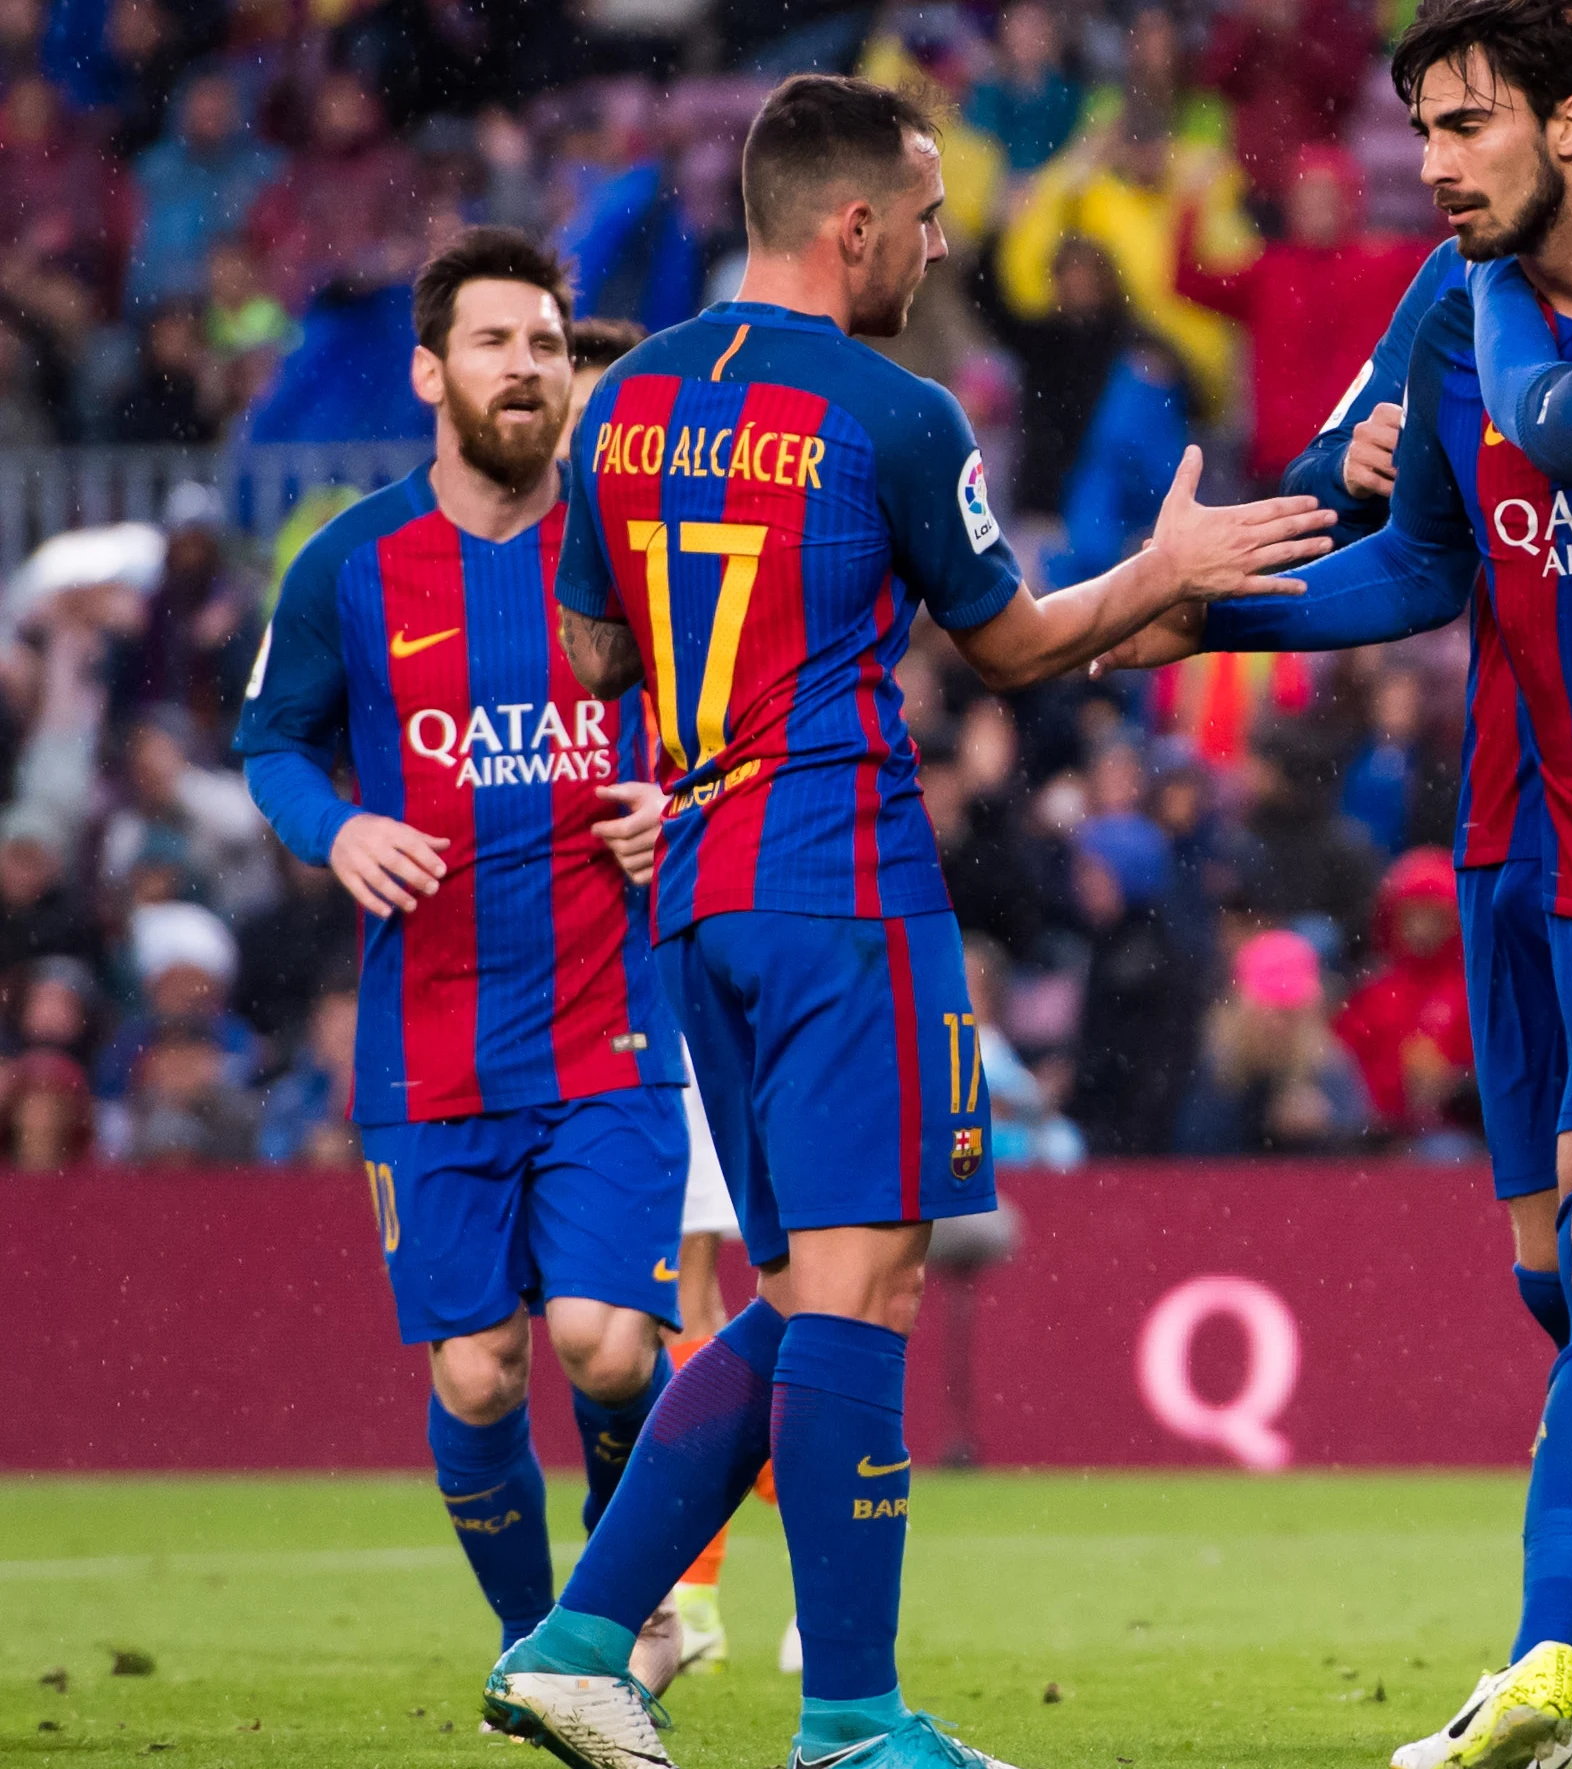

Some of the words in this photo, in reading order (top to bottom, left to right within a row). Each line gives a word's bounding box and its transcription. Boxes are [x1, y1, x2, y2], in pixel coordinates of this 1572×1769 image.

[592, 422, 666, 476] PACO
[669, 421, 826, 489] ALCÁCER
[627, 520, 769, 772] 17
[408, 699, 610, 767] QATAR
[456, 749, 612, 788] AIRWAYS
[943, 1013, 981, 1114] 17
[1137, 1275, 1301, 1470] Q
[853, 1498, 909, 1520] BAR
